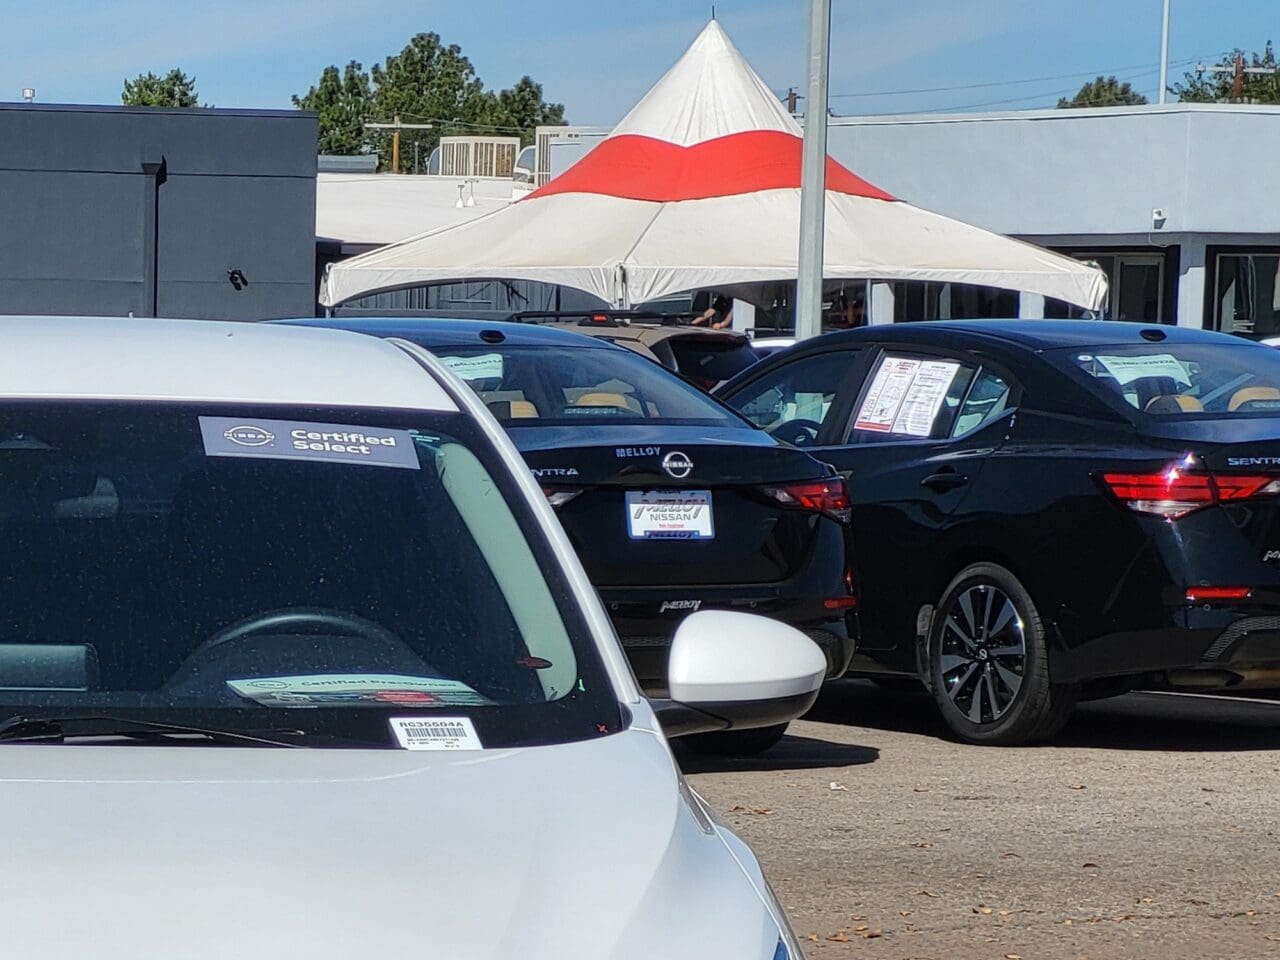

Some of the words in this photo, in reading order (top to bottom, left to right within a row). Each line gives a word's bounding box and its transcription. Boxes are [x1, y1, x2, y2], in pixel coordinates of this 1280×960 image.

[290, 429, 396, 447] Certified
[293, 440, 372, 455] Select
[615, 447, 661, 458] MELLOY
[662, 461, 694, 469] NISSAN
[1227, 457, 1280, 466] SENTR
[530, 468, 579, 477] NTRA
[649, 513, 692, 521] NISSAN
